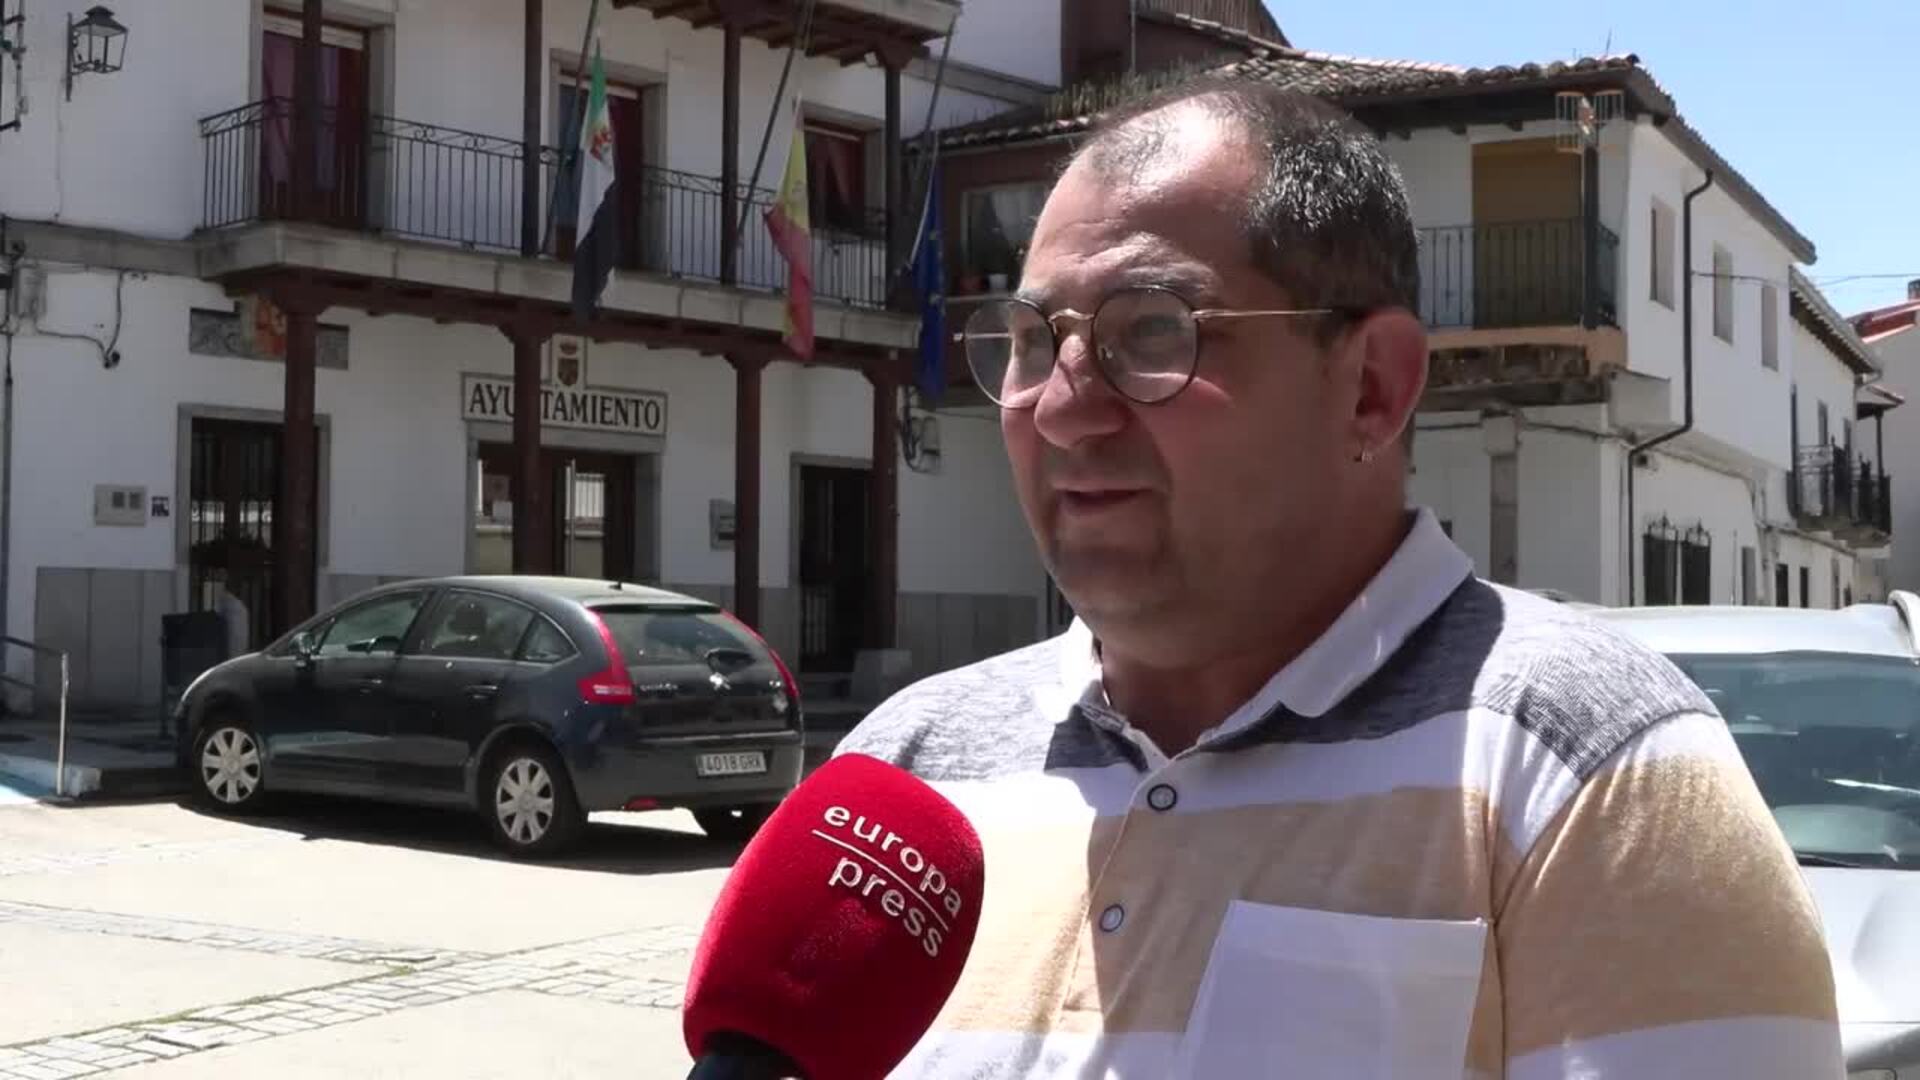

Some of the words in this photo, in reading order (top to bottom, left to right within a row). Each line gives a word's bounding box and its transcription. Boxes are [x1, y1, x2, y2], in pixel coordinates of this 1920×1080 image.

[468, 382, 661, 430] AYUTAMIENTO
[706, 755, 737, 771] 4018
[824, 806, 962, 918] europa
[828, 857, 943, 957] press
